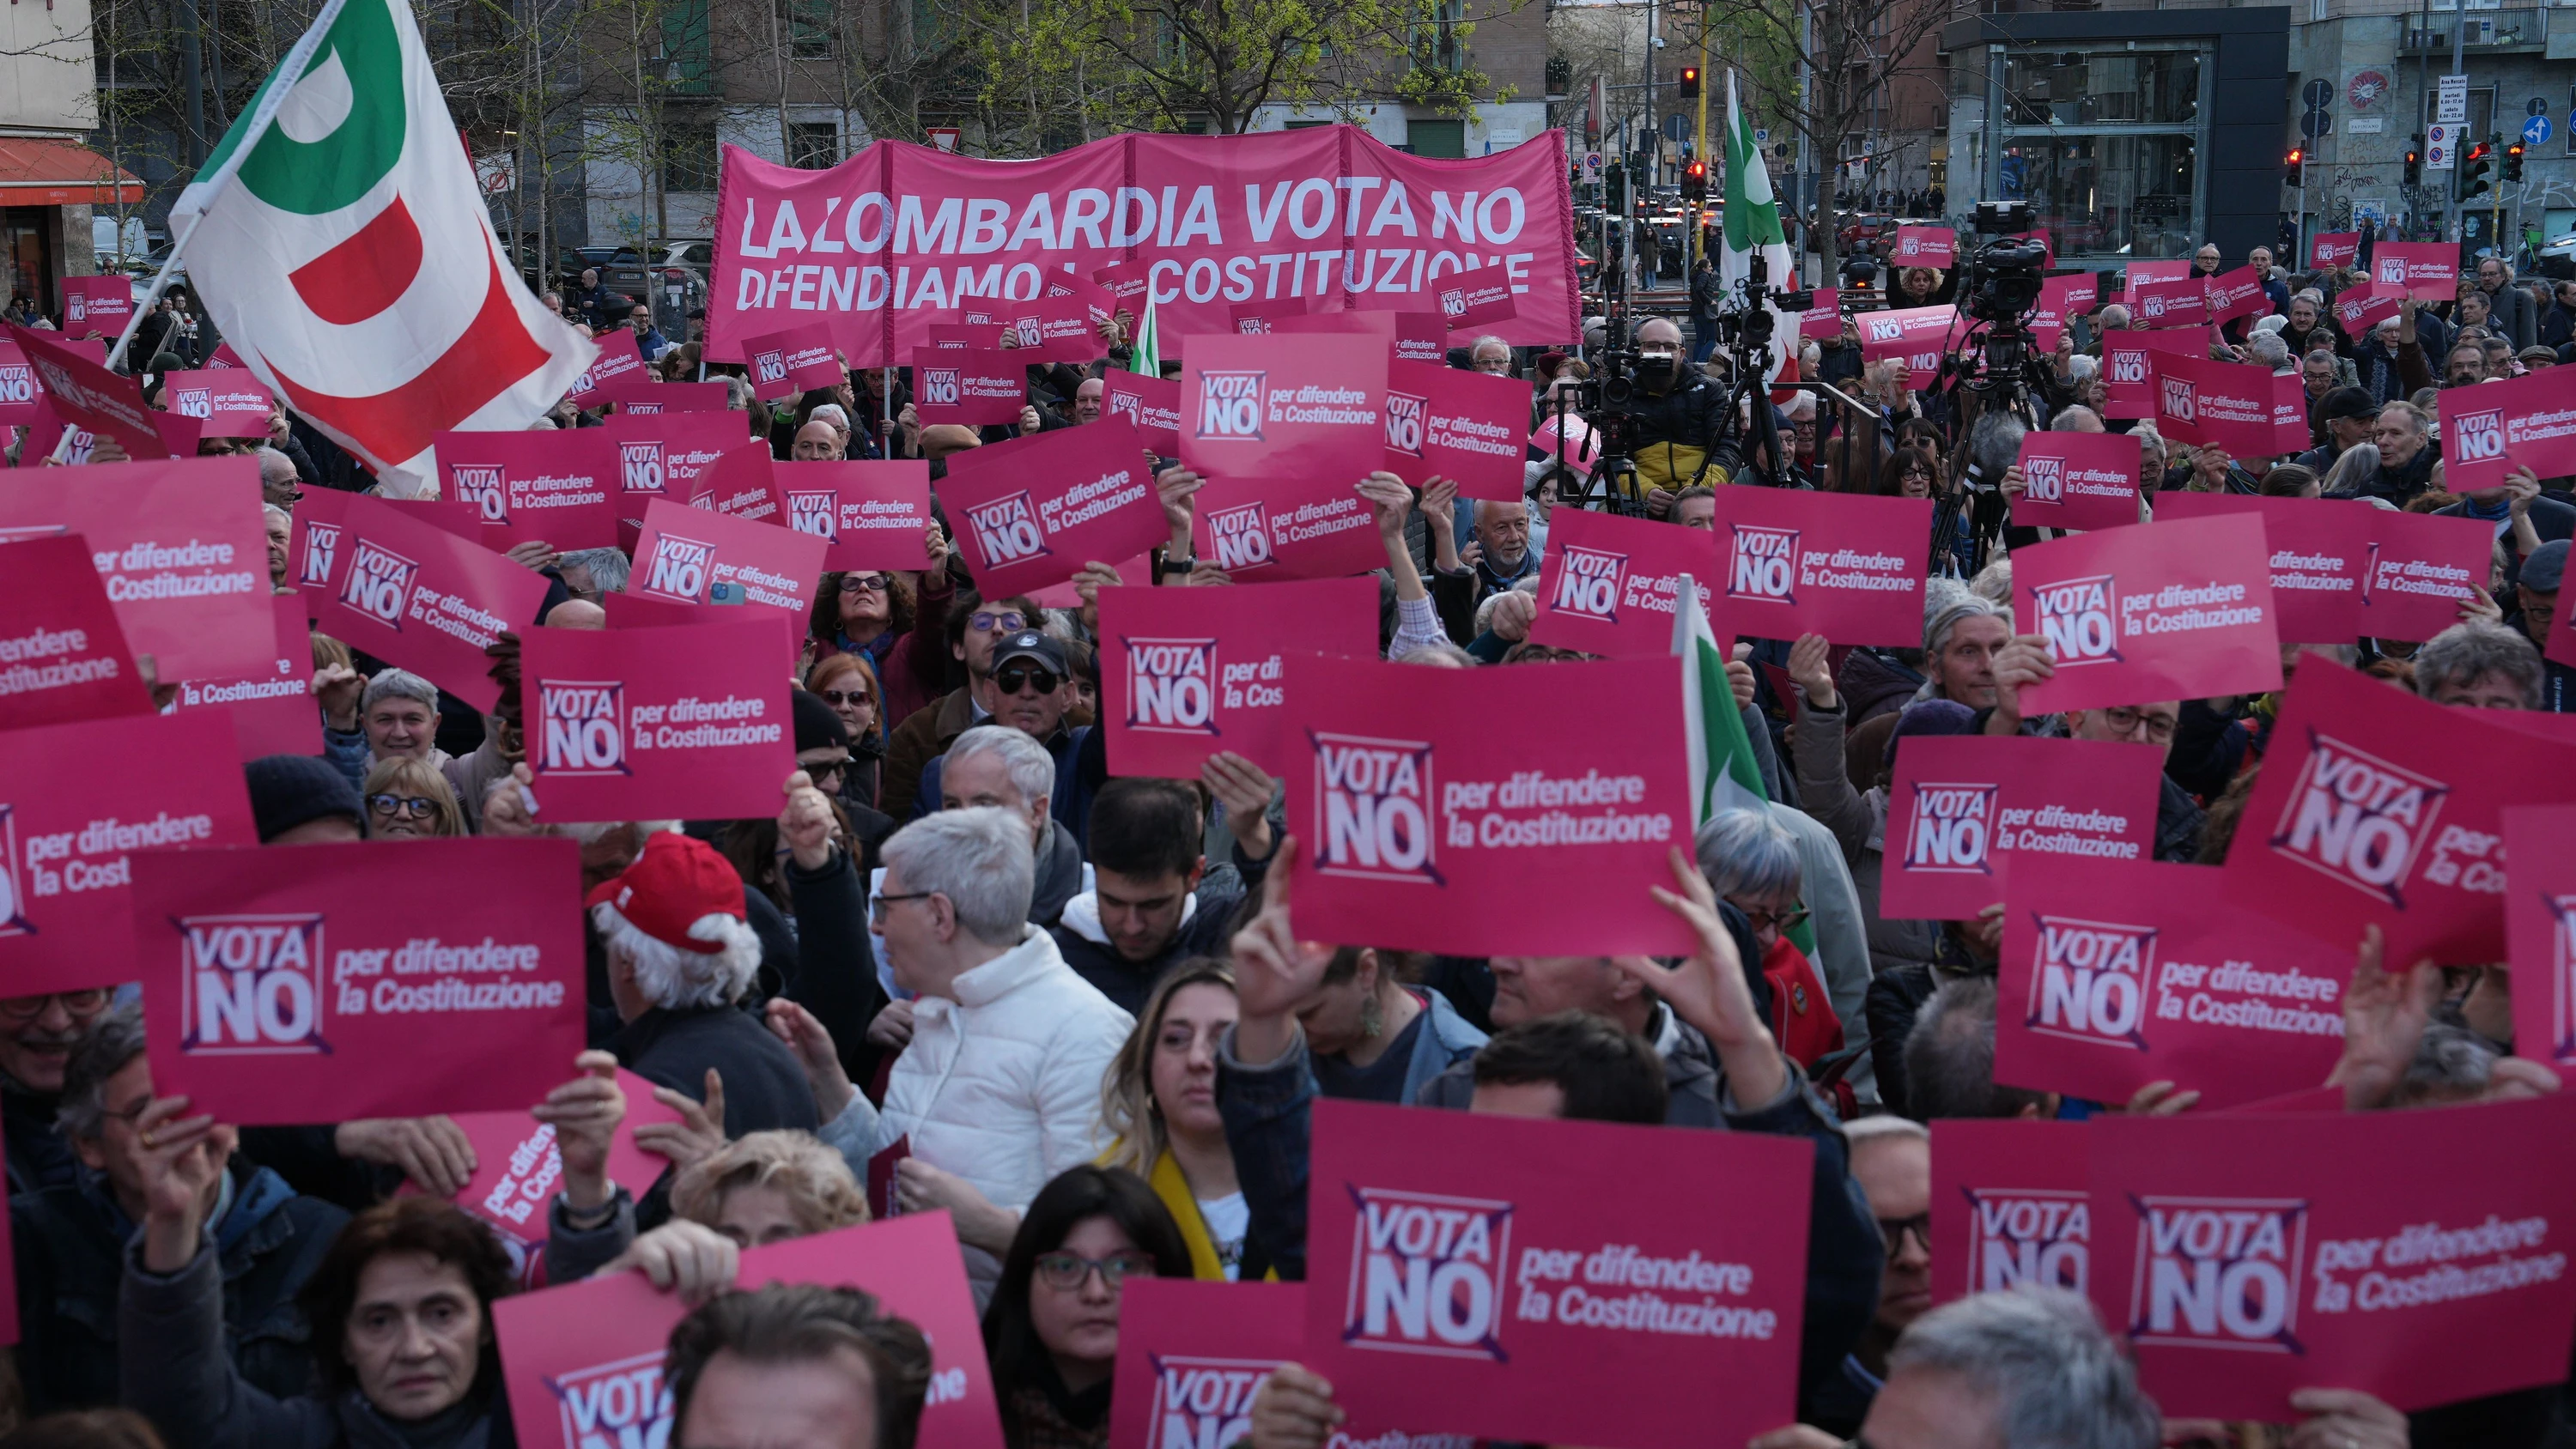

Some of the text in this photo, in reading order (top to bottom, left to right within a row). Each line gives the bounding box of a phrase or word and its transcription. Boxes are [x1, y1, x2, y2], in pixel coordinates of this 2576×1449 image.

[741, 177, 1525, 258] LA LOMBARDIA VOTA NO
[1903, 246, 1917, 254] NO
[2382, 258, 2404, 268] VOTA
[2382, 268, 2404, 282] NO
[1442, 291, 1461, 300] VOTA
[1474, 294, 1508, 305] Costituzione
[1476, 287, 1503, 297] difendere
[1443, 300, 1465, 315] NO
[1018, 318, 1037, 329] VOTA
[1019, 329, 1040, 346] NO
[1051, 328, 1087, 337] Costituzione
[1054, 319, 1081, 328] difendere
[1874, 324, 1899, 340] NO
[756, 353, 781, 364] VOTA
[787, 347, 826, 362] per difendere
[796, 355, 833, 368] Costituzione
[760, 363, 785, 382] NO
[926, 372, 956, 383] VOTA
[963, 378, 1014, 387] per difendere
[179, 391, 207, 403] VOTA
[228, 393, 262, 402] difendere
[927, 383, 957, 402] NO
[963, 386, 1021, 397] la Costituzione
[1205, 377, 1258, 397] VOTA
[1269, 385, 1365, 405] per difendere
[2163, 379, 2191, 397] VOTA
[181, 403, 210, 418] NO
[224, 403, 269, 411] Costituzione
[1207, 399, 1260, 433] NO
[1269, 405, 1376, 424] la Costituzione
[2166, 392, 2193, 420] NO
[2198, 396, 2259, 409] per difendere
[2199, 404, 2267, 422] la Costituzione
[2027, 460, 2060, 475] VOTA
[2067, 469, 2127, 483] per difendere
[1040, 470, 1129, 519] per difendere
[2028, 475, 2060, 500] NO
[2066, 480, 2133, 497] la Costituzione
[971, 498, 1028, 531] VOTA
[1047, 483, 1145, 534] la Costituzione
[982, 522, 1040, 563] NO
[1738, 532, 1792, 557] VOTA
[122, 543, 234, 571] difendere
[1802, 549, 1905, 570] per difendere
[2269, 550, 2344, 572] difendere
[106, 572, 254, 602] Costituzione
[1735, 556, 1791, 597] NO
[1801, 567, 1915, 591] la Costituzione
[2038, 585, 2106, 614] VOTA
[2123, 581, 2245, 617] per difendere
[2123, 606, 2262, 635] la Costituzione
[2045, 613, 2111, 658] NO
[544, 688, 614, 717] VOTA
[633, 696, 764, 725] per difendere
[547, 719, 621, 768] NO
[635, 720, 781, 748] la Costituzione
[1322, 749, 1420, 797] VOTA
[1443, 772, 1644, 815] per difendere
[1917, 791, 1984, 817] VOTA
[1327, 793, 1426, 868] NO
[1447, 808, 1672, 846] la Costituzione
[1999, 805, 2127, 833] per difendere
[1915, 817, 1986, 867] NO
[1997, 825, 2139, 859] la Costituzione
[192, 927, 307, 969] VOTA
[334, 940, 540, 980] per difendere
[2044, 927, 2138, 973] VOTA
[2160, 960, 2338, 1001] per difendere
[200, 972, 314, 1041] NO
[337, 978, 564, 1013] la Costituzione
[2039, 965, 2138, 1034] NO
[2157, 989, 2184, 1019] la
[1365, 1206, 1492, 1260] VOTA
[2150, 1211, 2284, 1258] VOTA
[2314, 1215, 2548, 1276] per difendere
[1517, 1245, 1753, 1294] per difendere
[2316, 1253, 2565, 1313] la Costituzione
[1365, 1256, 1494, 1343] NO
[1516, 1286, 1776, 1338] la Costituzione
[2150, 1258, 2288, 1340] NO
